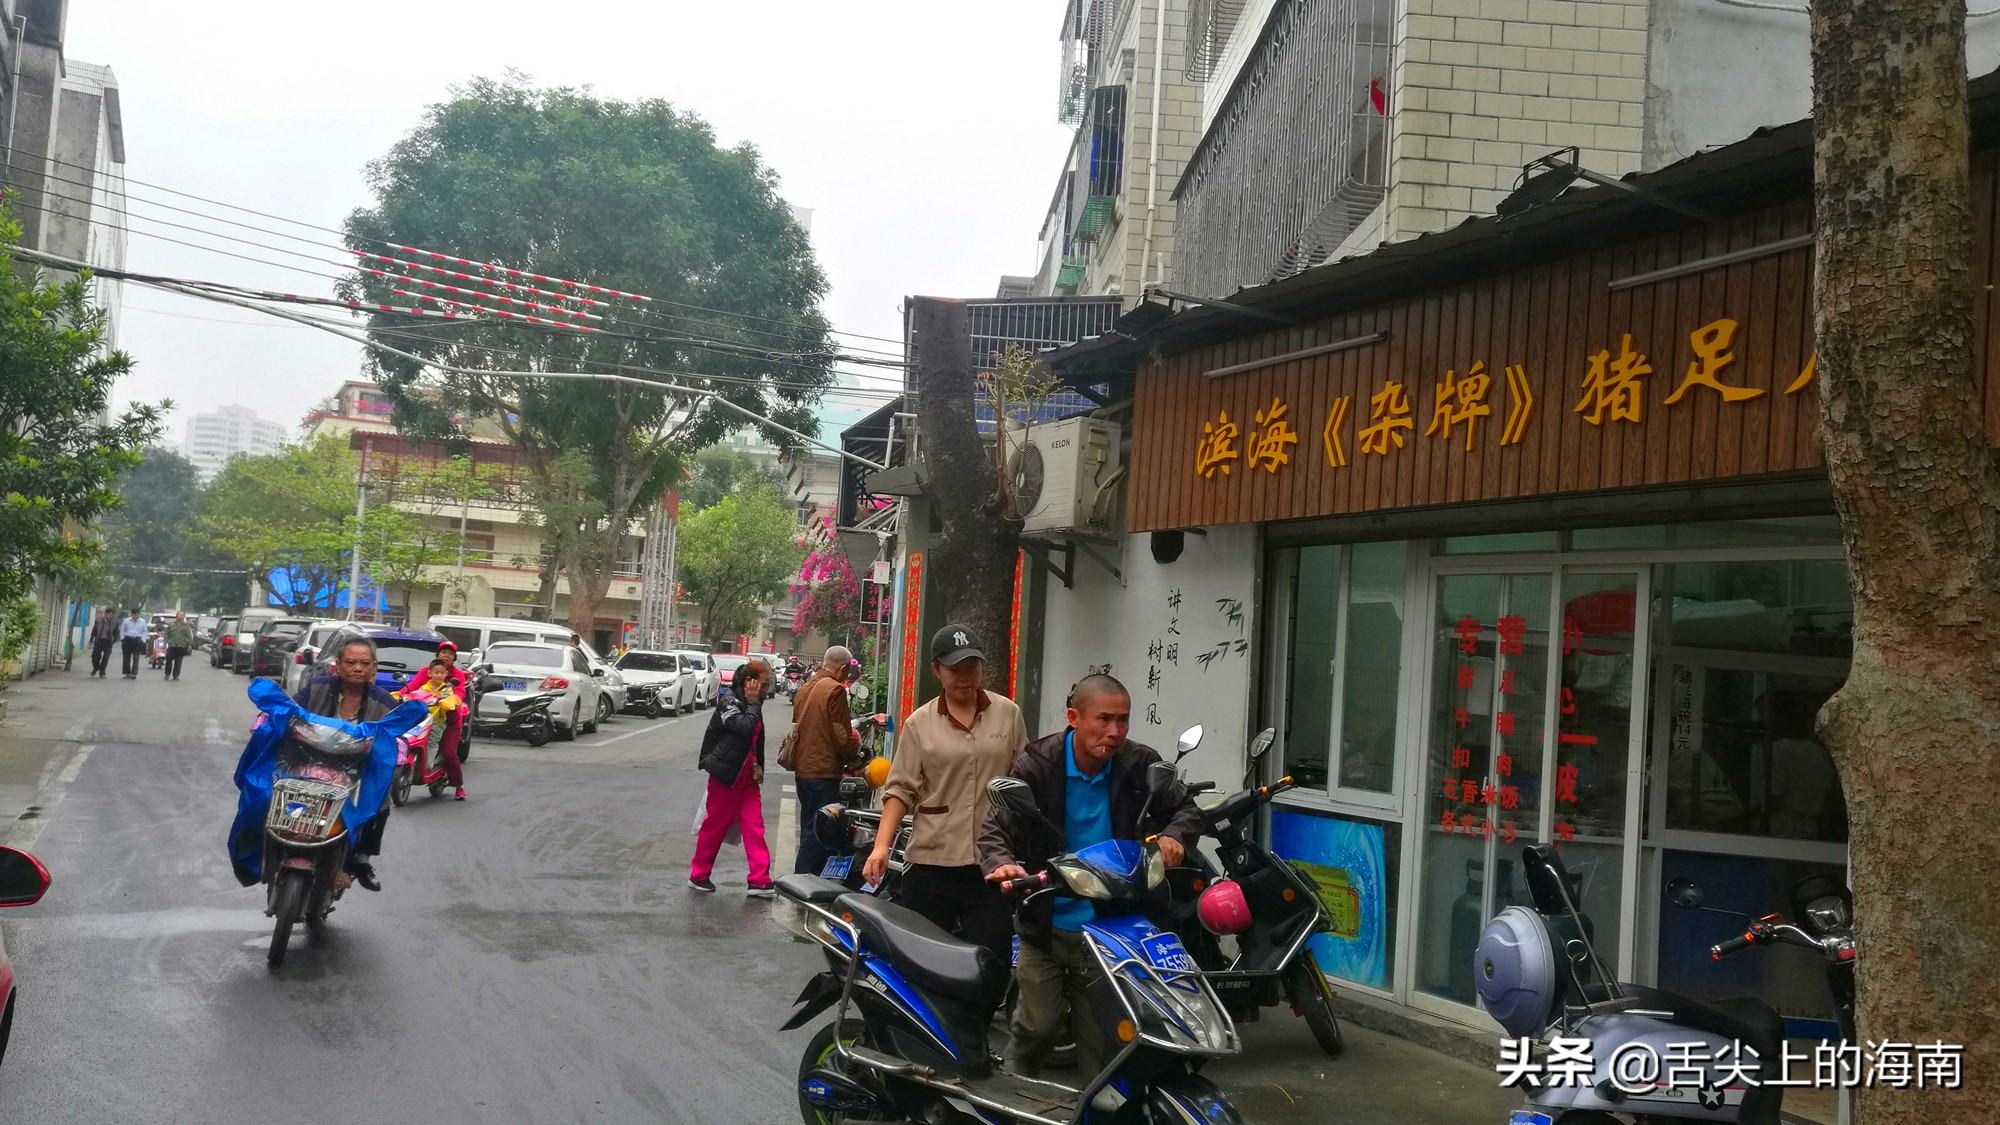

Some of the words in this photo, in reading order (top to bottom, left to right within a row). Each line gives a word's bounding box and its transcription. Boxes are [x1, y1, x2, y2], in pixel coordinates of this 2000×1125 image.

[1196, 318, 1817, 479] 滨海《杂牌》猪足
[1051, 438, 1071, 449] KELON
[1166, 588, 1182, 667] 讲文明
[1455, 614, 1527, 655] 专营
[1146, 639, 1163, 725] 树新风
[1455, 708, 1516, 735] 牛腩
[1453, 745, 1512, 777] 扣肉
